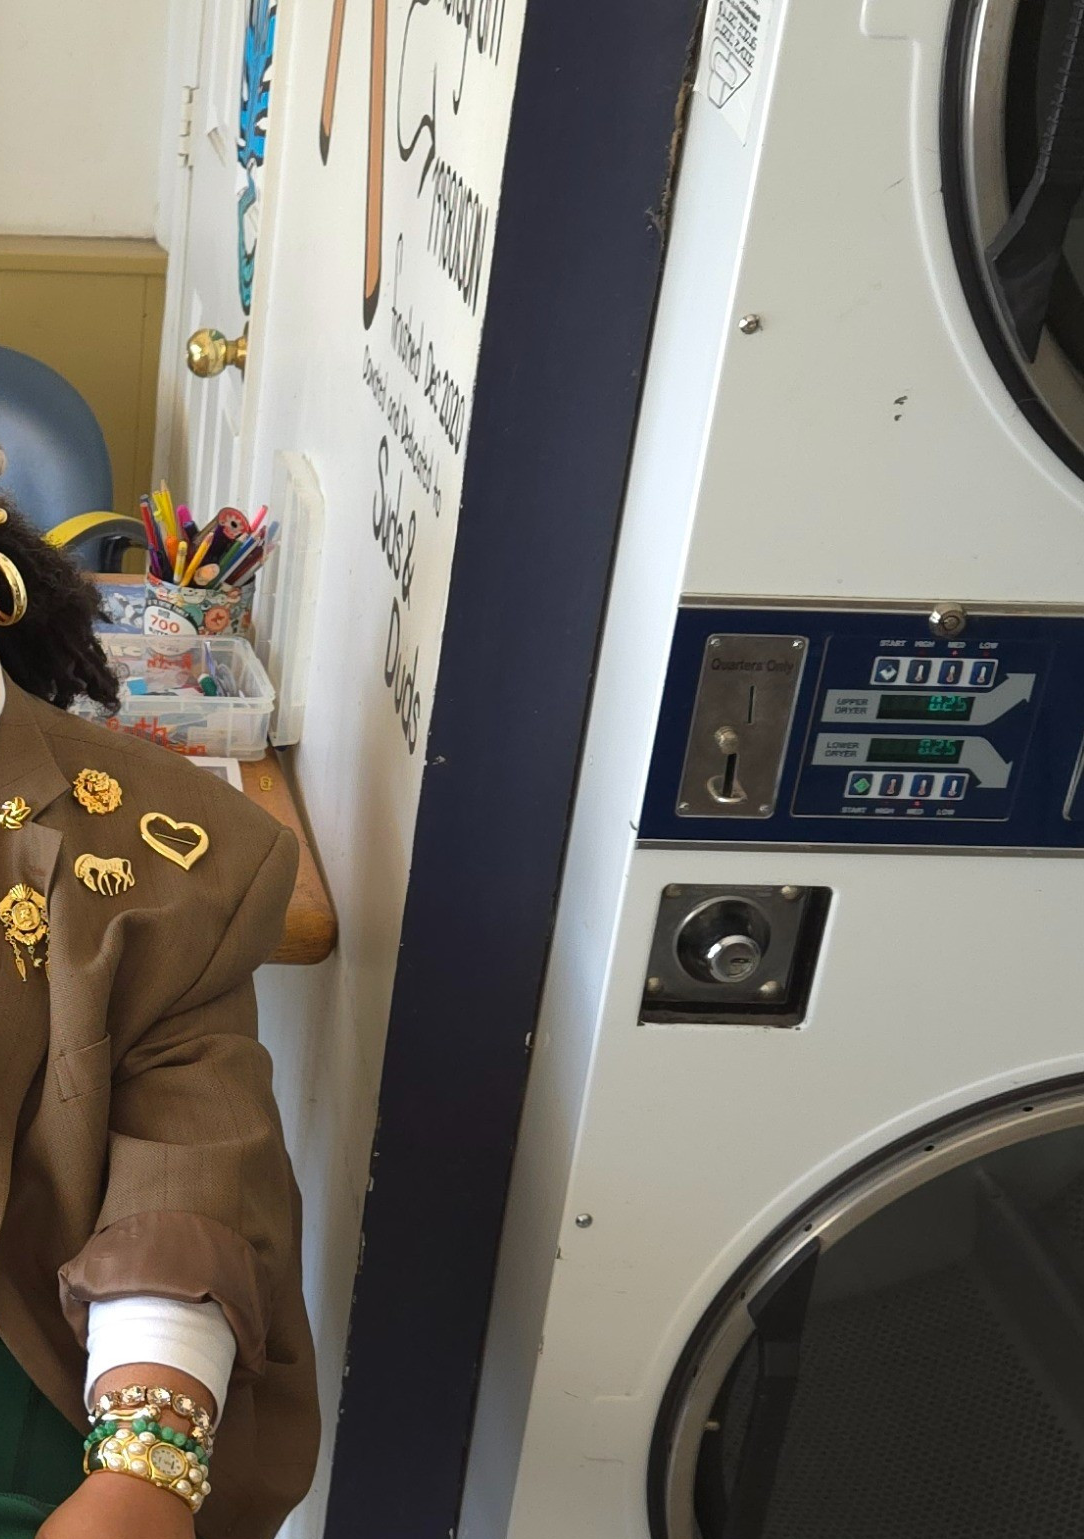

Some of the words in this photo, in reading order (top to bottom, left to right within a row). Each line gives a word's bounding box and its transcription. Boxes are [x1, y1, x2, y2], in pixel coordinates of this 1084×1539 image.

[424, 340, 441, 414] Dec
[439, 369, 465, 455] 2020
[372, 434, 404, 582] Suds
[401, 509, 416, 611] &
[150, 614, 181, 634] 700
[978, 641, 999, 650] LOW
[711, 657, 764, 671] Quarters
[766, 659, 794, 675] Only
[384, 596, 421, 756] Duds
[836, 698, 868, 706] UPPER
[834, 706, 868, 715] DRYER
[826, 741, 860, 750] LOWER
[824, 750, 858, 758] DRYER
